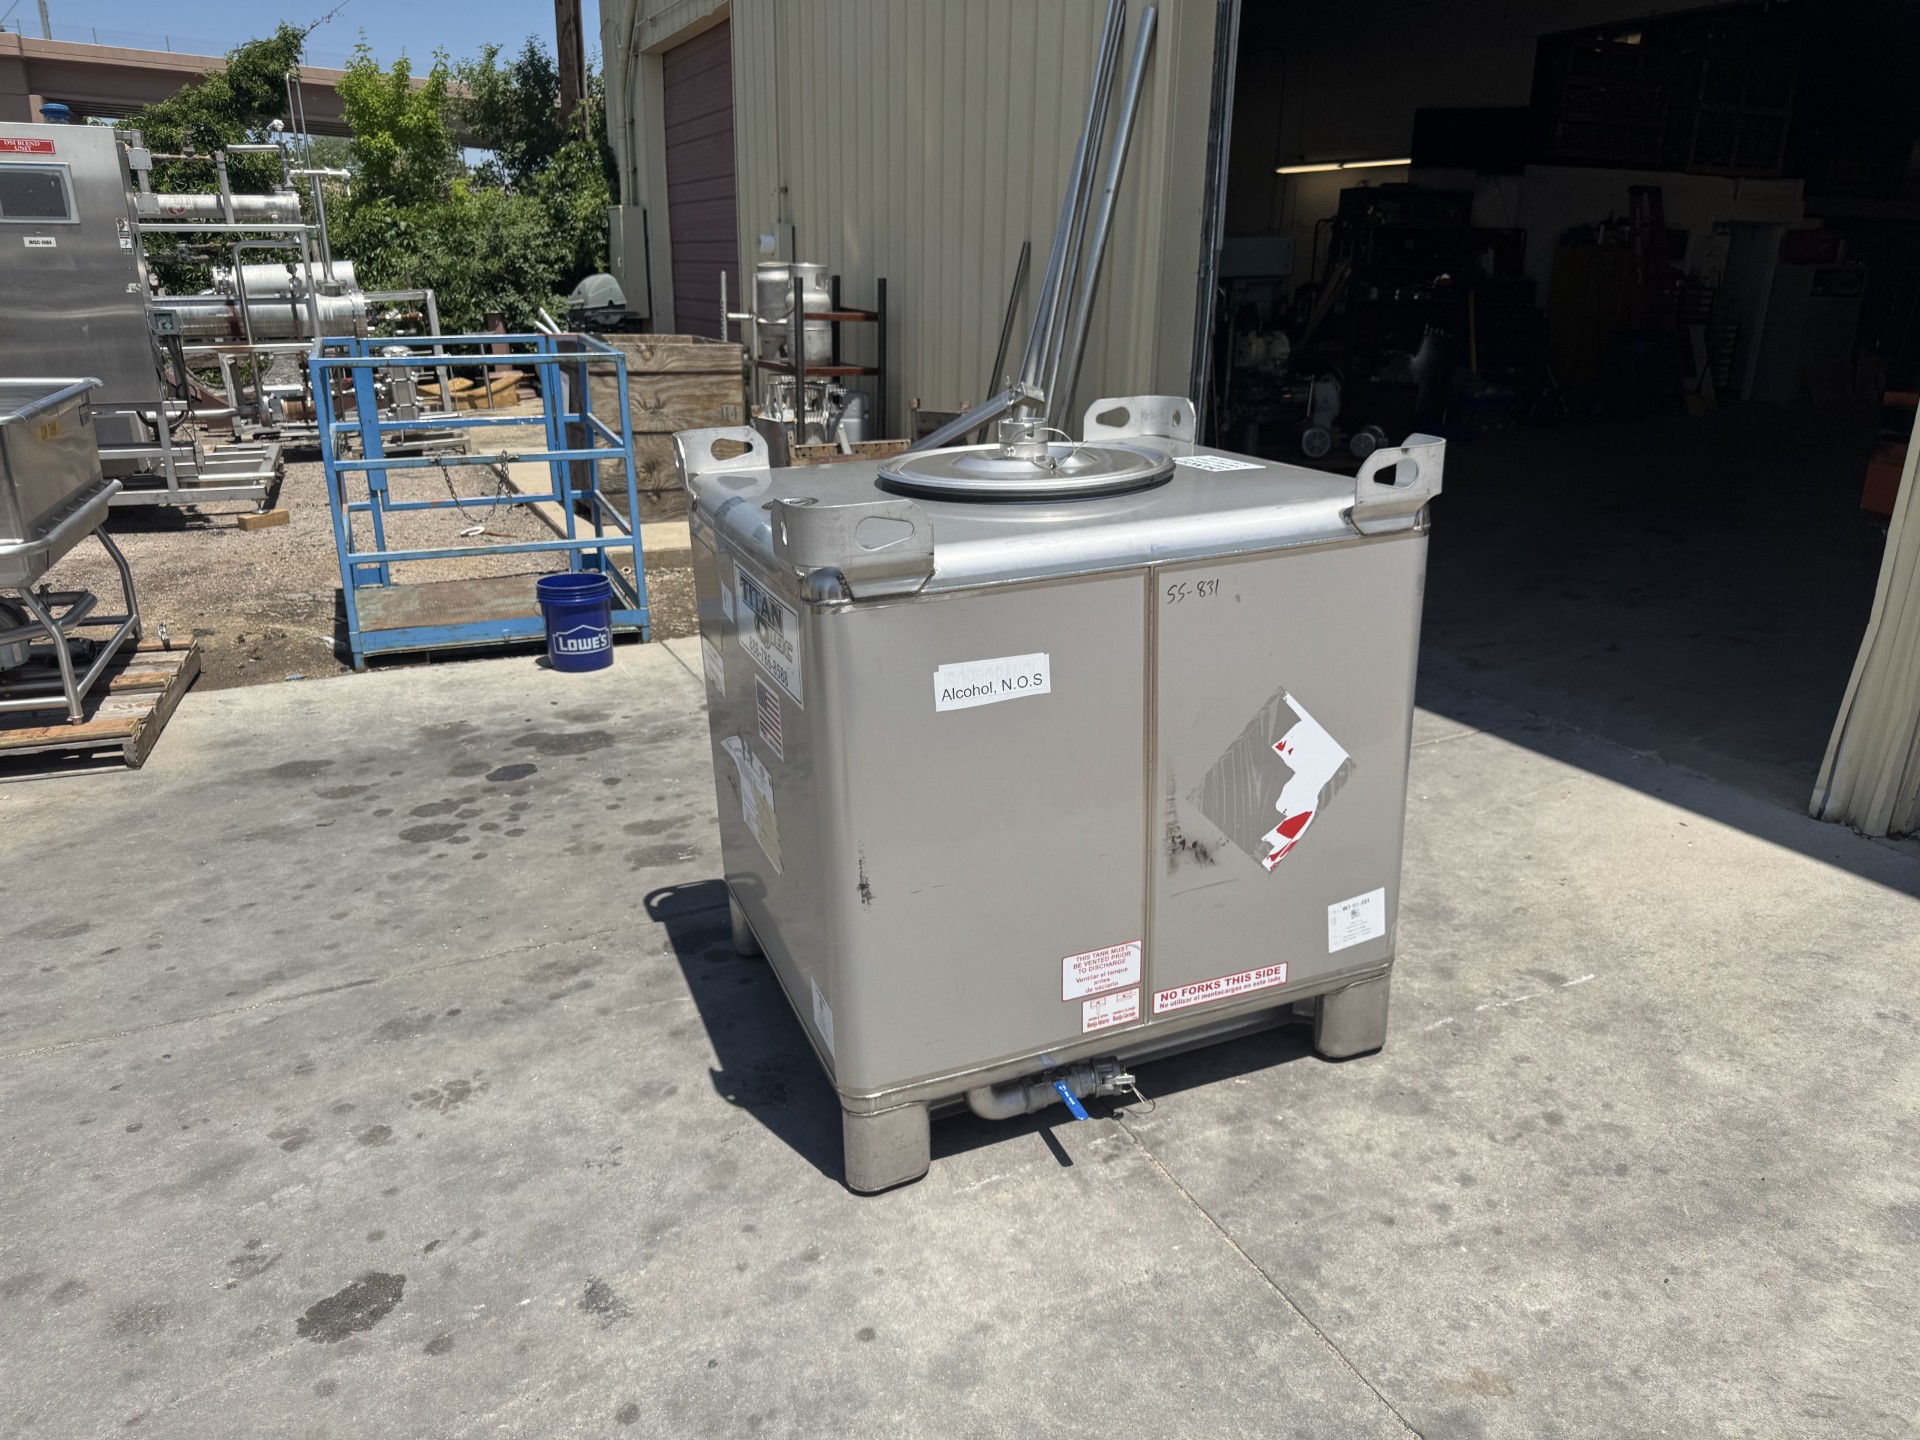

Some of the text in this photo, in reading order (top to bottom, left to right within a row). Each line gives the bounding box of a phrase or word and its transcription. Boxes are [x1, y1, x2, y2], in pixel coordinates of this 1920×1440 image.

[740, 573, 784, 638] TITAN
[558, 633, 608, 652] LOWE'S
[771, 626, 794, 664] IBC
[942, 673, 1043, 702] Alcohol, N.O.S
[1076, 945, 1128, 963] THIS TANK MUST
[1084, 956, 1110, 968] VENTED
[1111, 951, 1131, 960] PRIOR
[1088, 958, 1126, 972] DISCHARGE
[1076, 974, 1098, 983] Ventilar
[1108, 967, 1128, 976] tanque
[1160, 966, 1280, 1002] NO FORKS THIS SIDE
[1094, 981, 1118, 990] vaciarlo
[1170, 997, 1192, 1006] utilizar
[1202, 986, 1242, 999] montacargas
